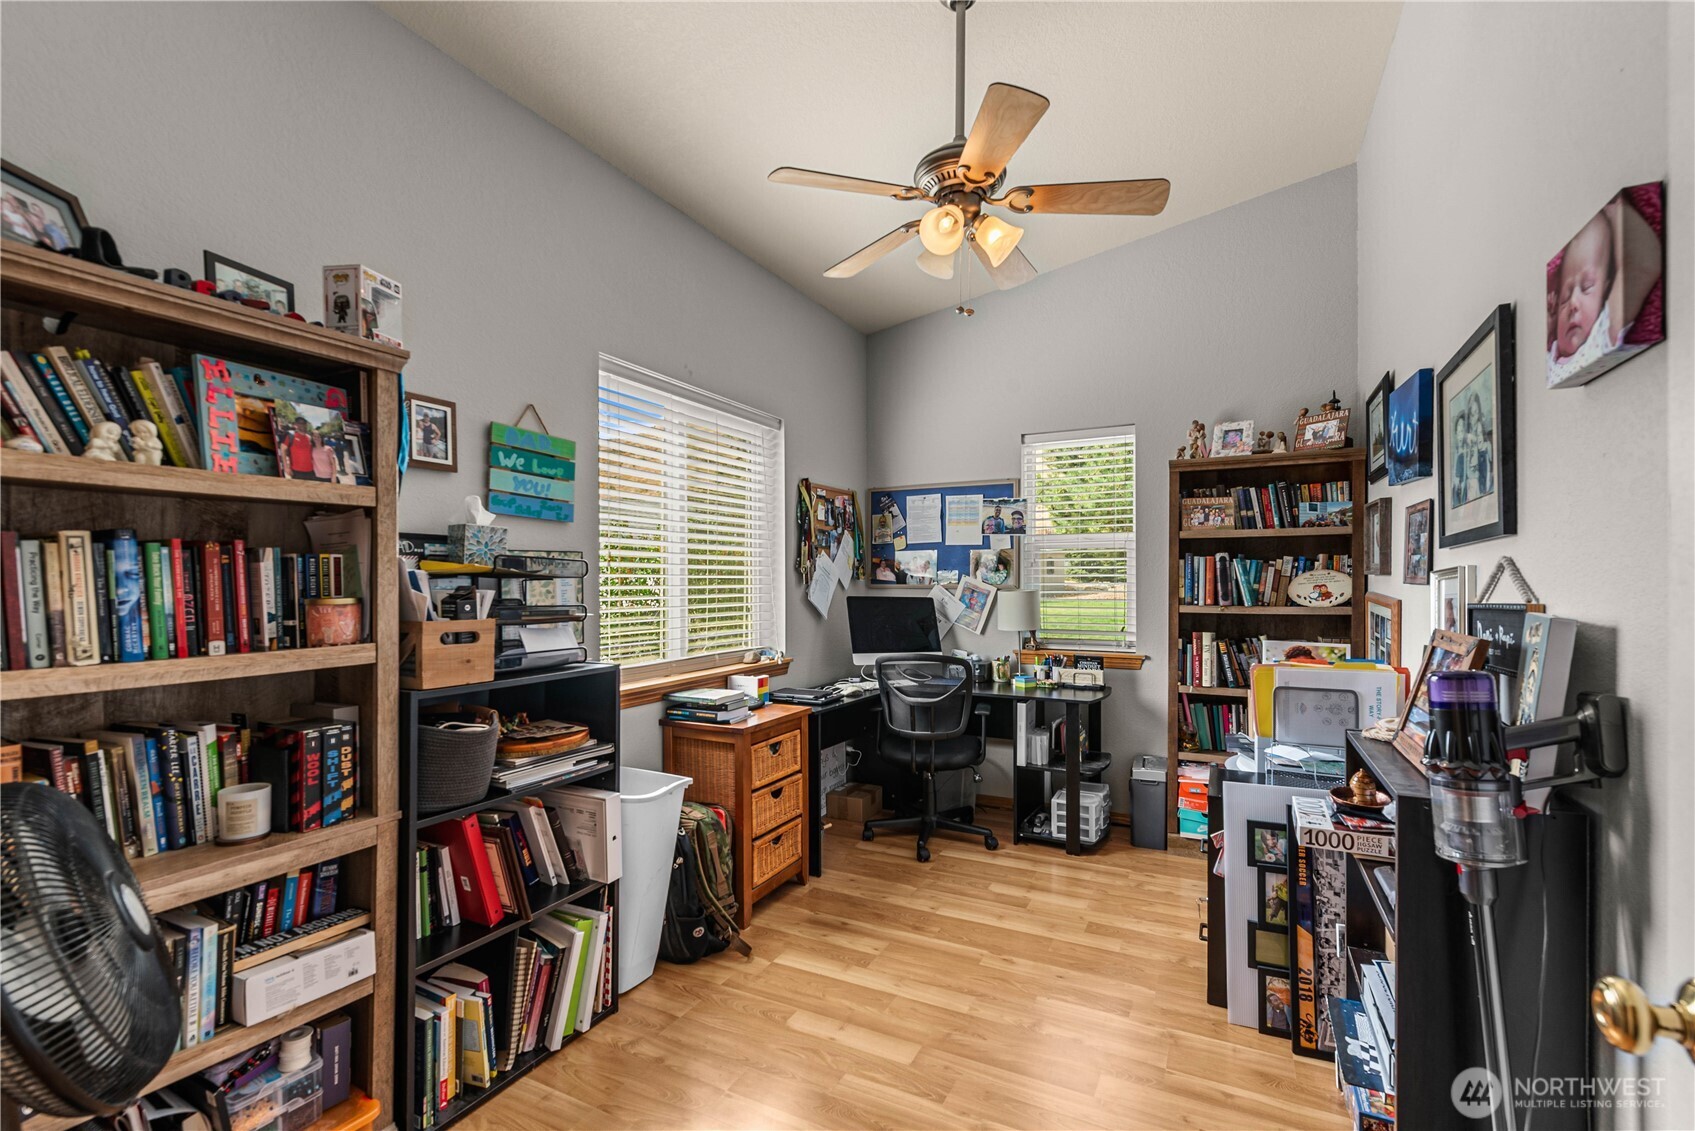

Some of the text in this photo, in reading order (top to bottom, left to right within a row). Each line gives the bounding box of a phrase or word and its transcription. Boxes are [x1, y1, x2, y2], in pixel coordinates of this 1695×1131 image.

[200, 359, 239, 475] ELLIE
[1299, 409, 1349, 425] GUADALAJARA
[505, 427, 552, 450] DAD
[498, 451, 525, 470] We
[28, 552, 38, 586] Practicing
[32, 600, 40, 614] Way
[168, 729, 180, 774] HARPER LEE
[341, 745, 352, 777] DUST
[306, 753, 320, 786] WOOL
[327, 749, 339, 788] SHIFT
[140, 789, 151, 819] REALM
[1304, 829, 1383, 851] 1000 PIECE
[1299, 859, 1307, 886] SOCCER
[254, 931, 292, 948] NOT
[293, 908, 363, 934] ARGUING
[190, 974, 198, 990] YOU
[1299, 968, 1313, 1003] 2018
[189, 991, 198, 1018] RETIRE
